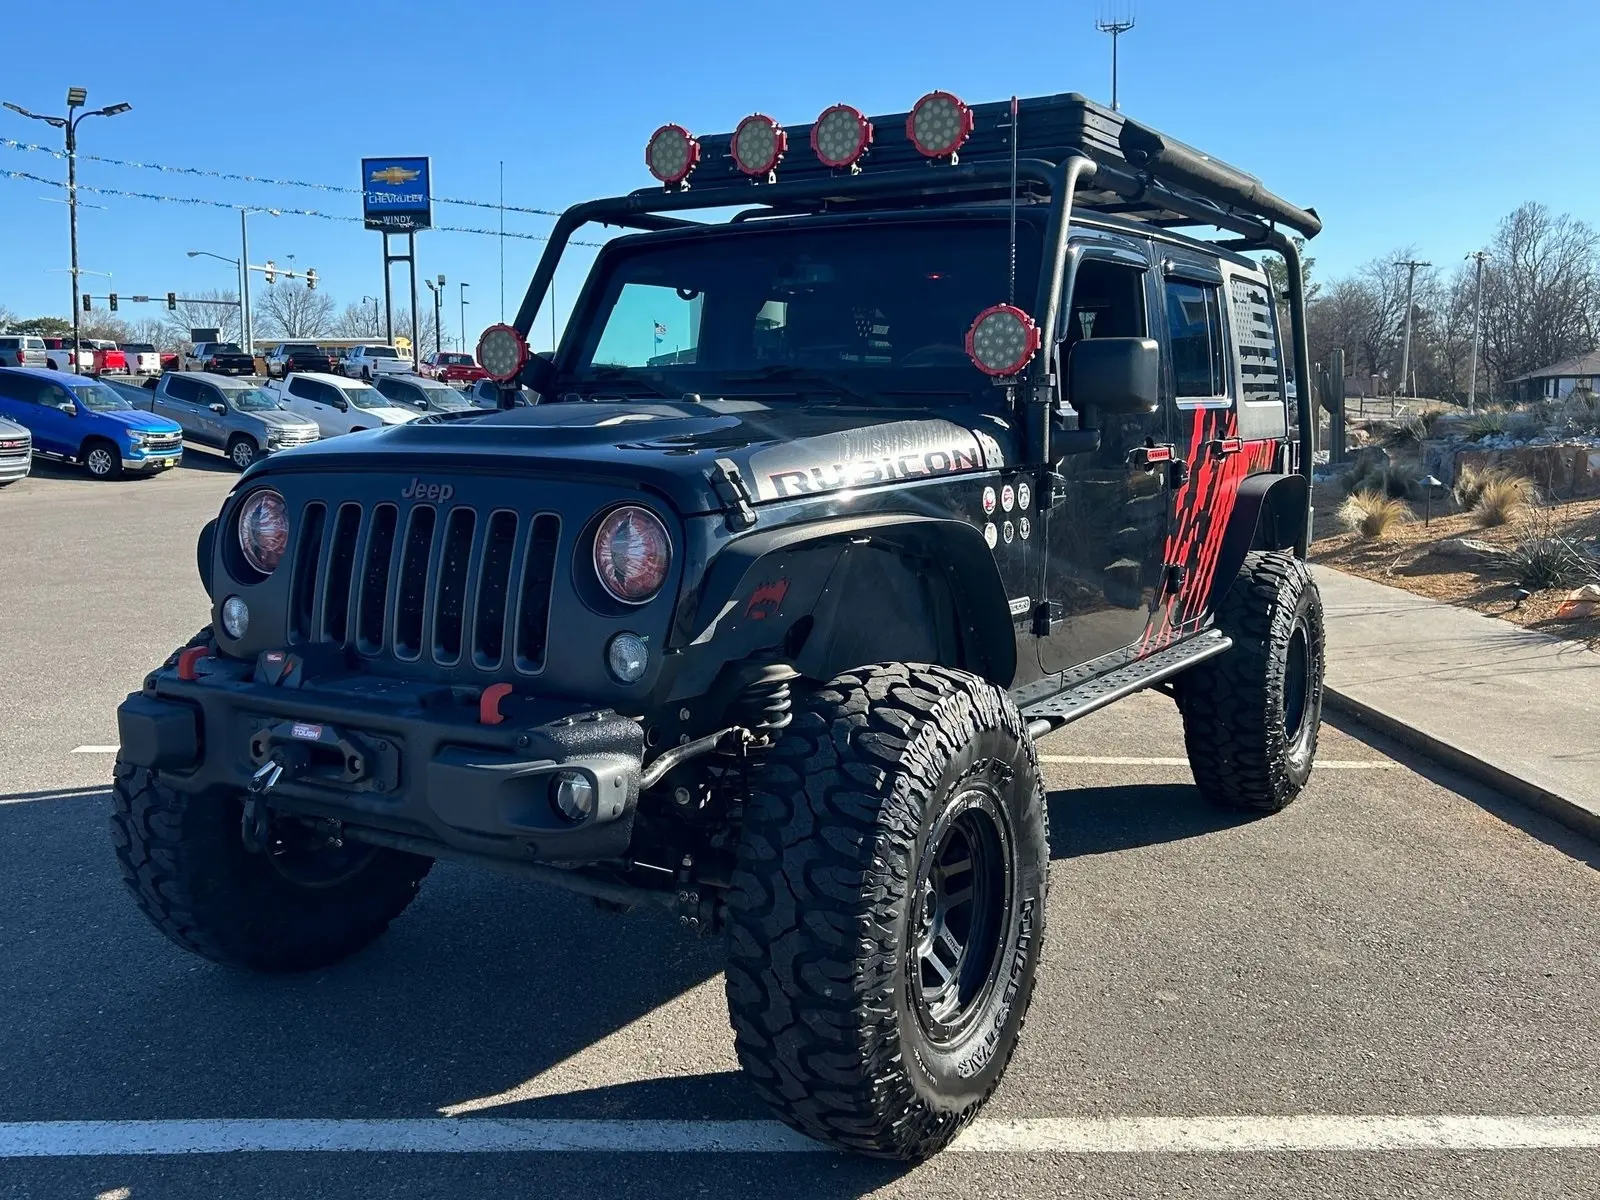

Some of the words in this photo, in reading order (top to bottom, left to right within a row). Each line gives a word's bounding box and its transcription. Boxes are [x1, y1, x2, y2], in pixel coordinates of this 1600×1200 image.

[382, 215, 411, 224] WINDY
[769, 447, 983, 498] RUBICON
[401, 477, 454, 503] Jeep
[294, 728, 319, 738] TOUGH
[958, 897, 1035, 1079] MILESTAR
